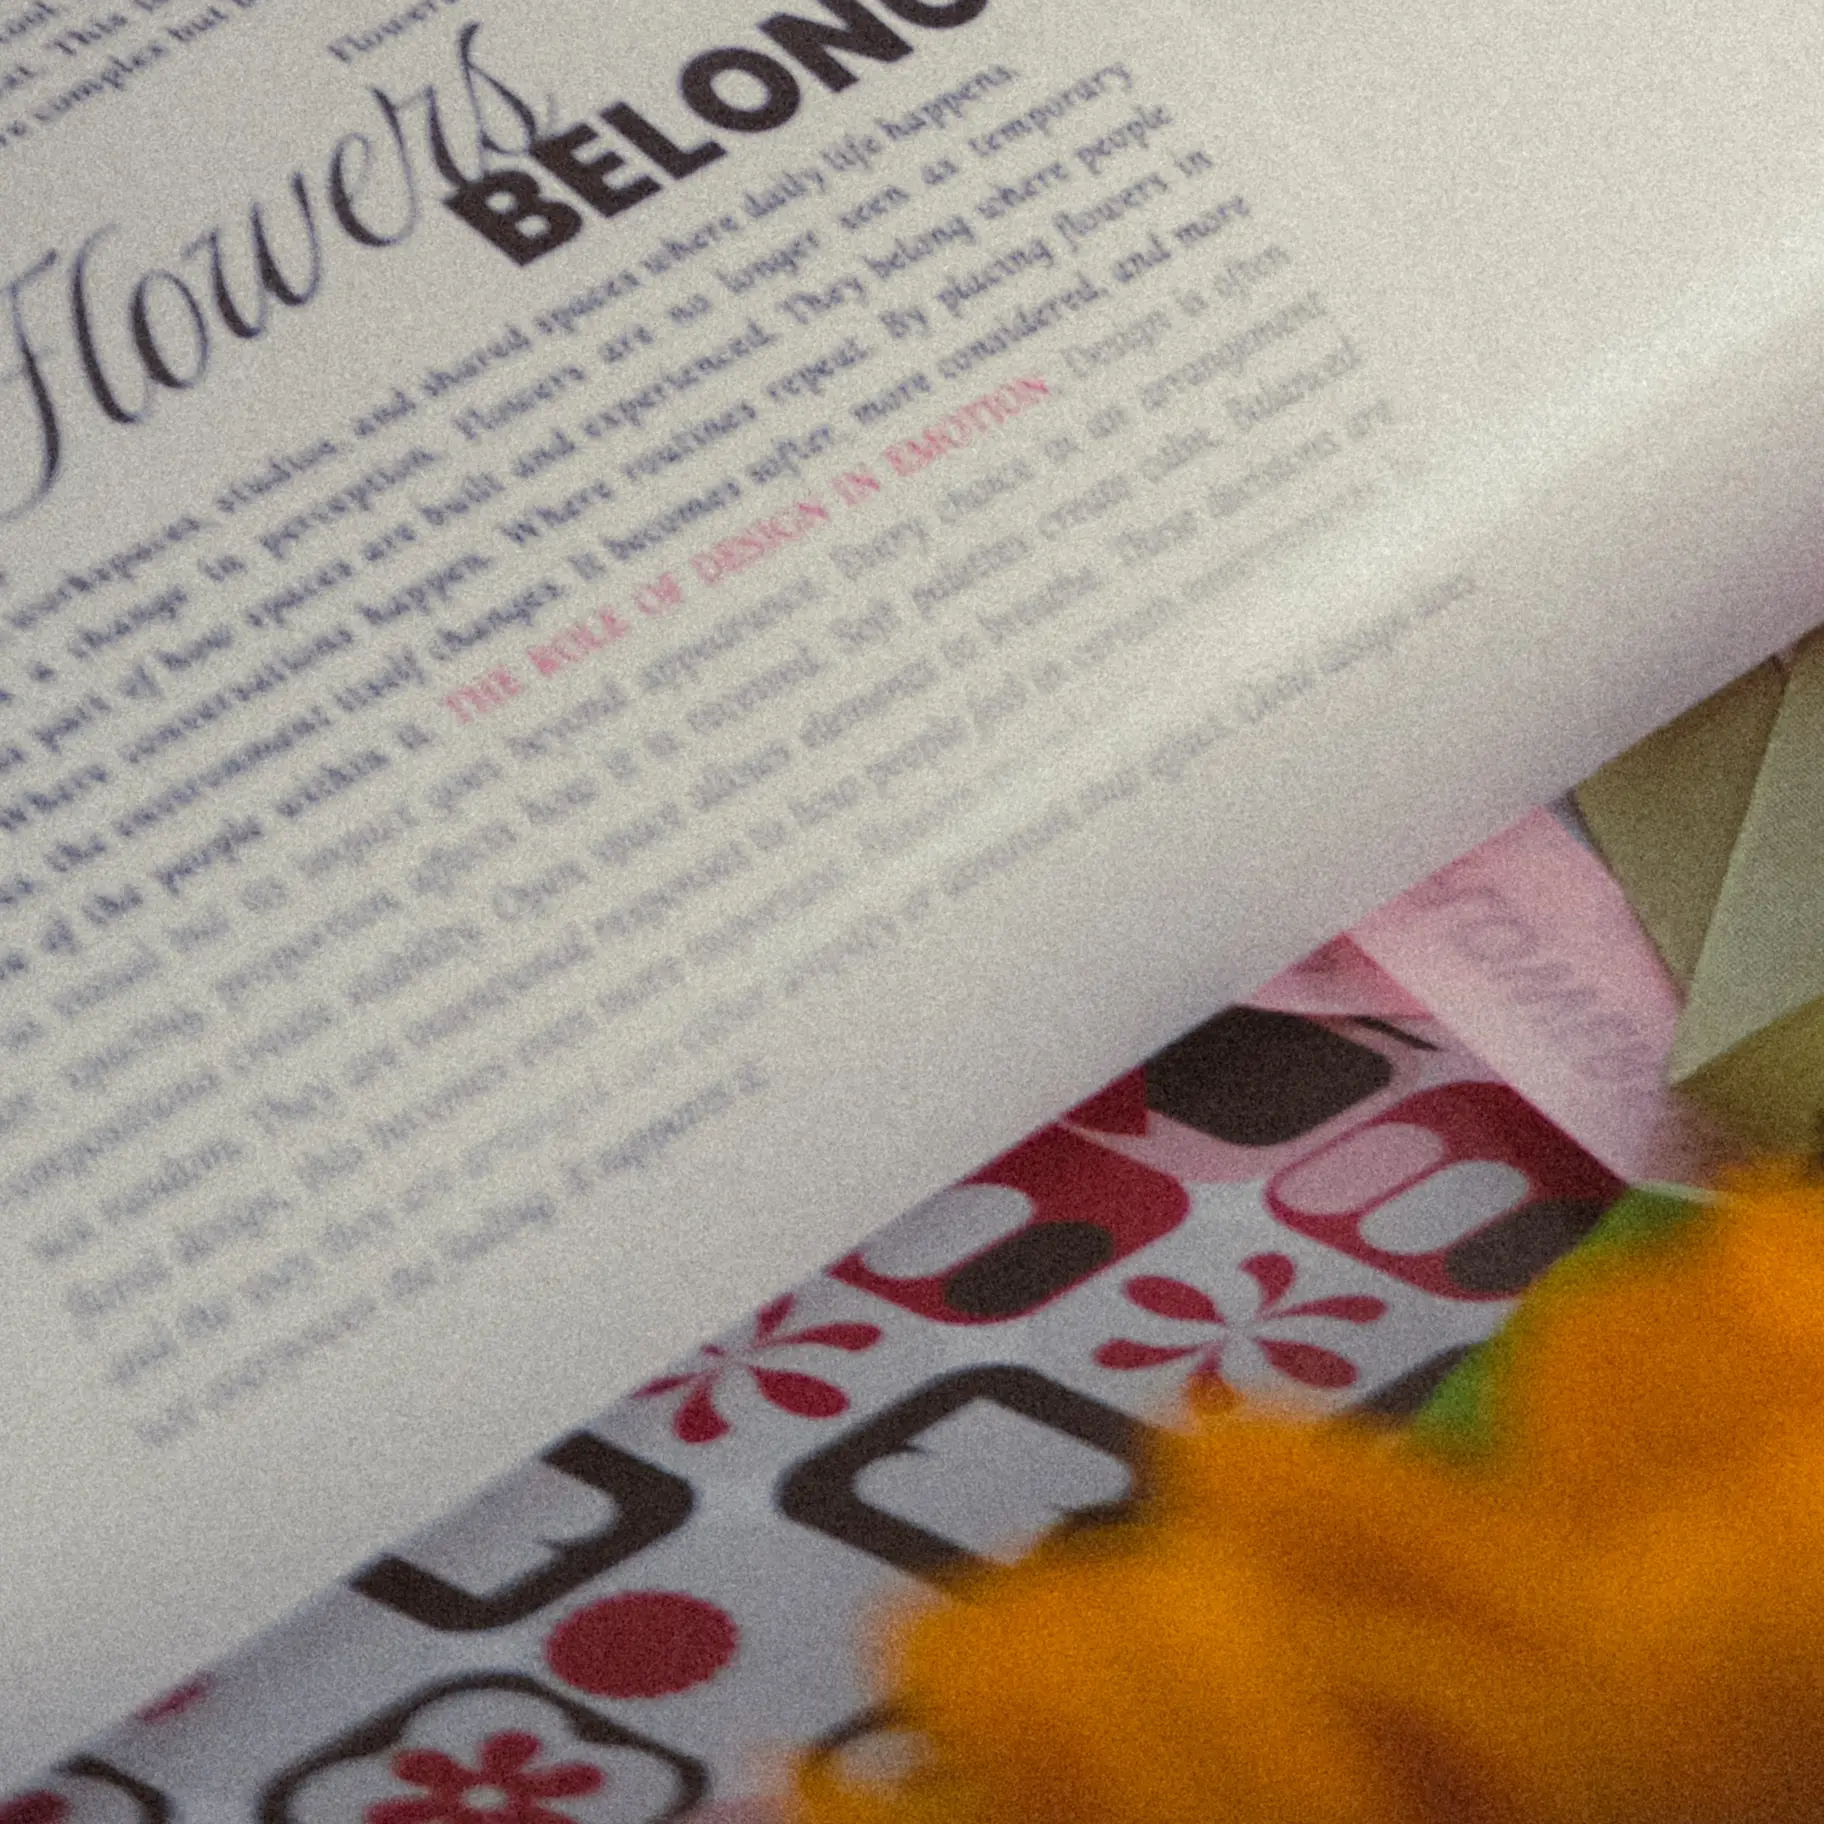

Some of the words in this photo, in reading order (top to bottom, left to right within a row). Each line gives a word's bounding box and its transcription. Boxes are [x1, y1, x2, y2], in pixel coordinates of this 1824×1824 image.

[31, 41, 168, 124] complex
[164, 5, 230, 45] but
[45, 12, 129, 58] This
[68, 584, 190, 661] change
[198, 553, 247, 583] in
[450, 363, 589, 443] Flowers
[597, 323, 655, 365] are
[664, 292, 714, 326] no
[714, 229, 821, 296] longer
[835, 183, 911, 233] seen
[920, 156, 961, 188] as
[965, 61, 1133, 159] temporary
[154, 625, 235, 673] how
[243, 558, 355, 630] spaces
[360, 521, 418, 565] are
[415, 471, 506, 528] built
[511, 427, 580, 480] and
[776, 274, 868, 326] They
[860, 214, 978, 282] belong
[973, 159, 1071, 221] where
[1071, 104, 1173, 177] people
[352, 387, 419, 439] and
[419, 323, 533, 400] shared
[532, 269, 641, 337] spaces
[639, 213, 742, 276] where
[742, 167, 828, 221] daily
[819, 133, 884, 173] life
[497, 479, 615, 547] Where
[620, 399, 759, 483] routines
[877, 304, 930, 341] By
[934, 237, 1056, 319] placing
[1050, 170, 1171, 255] flowers
[1172, 148, 1214, 179] in
[600, 478, 743, 563] becomes
[849, 370, 933, 426] more
[1111, 231, 1173, 285] and
[1170, 194, 1251, 249] more
[439, 664, 525, 724] THE
[525, 607, 630, 678] ROLE
[632, 570, 685, 617] OF
[689, 498, 831, 587] DESIGN
[831, 469, 882, 506] IN
